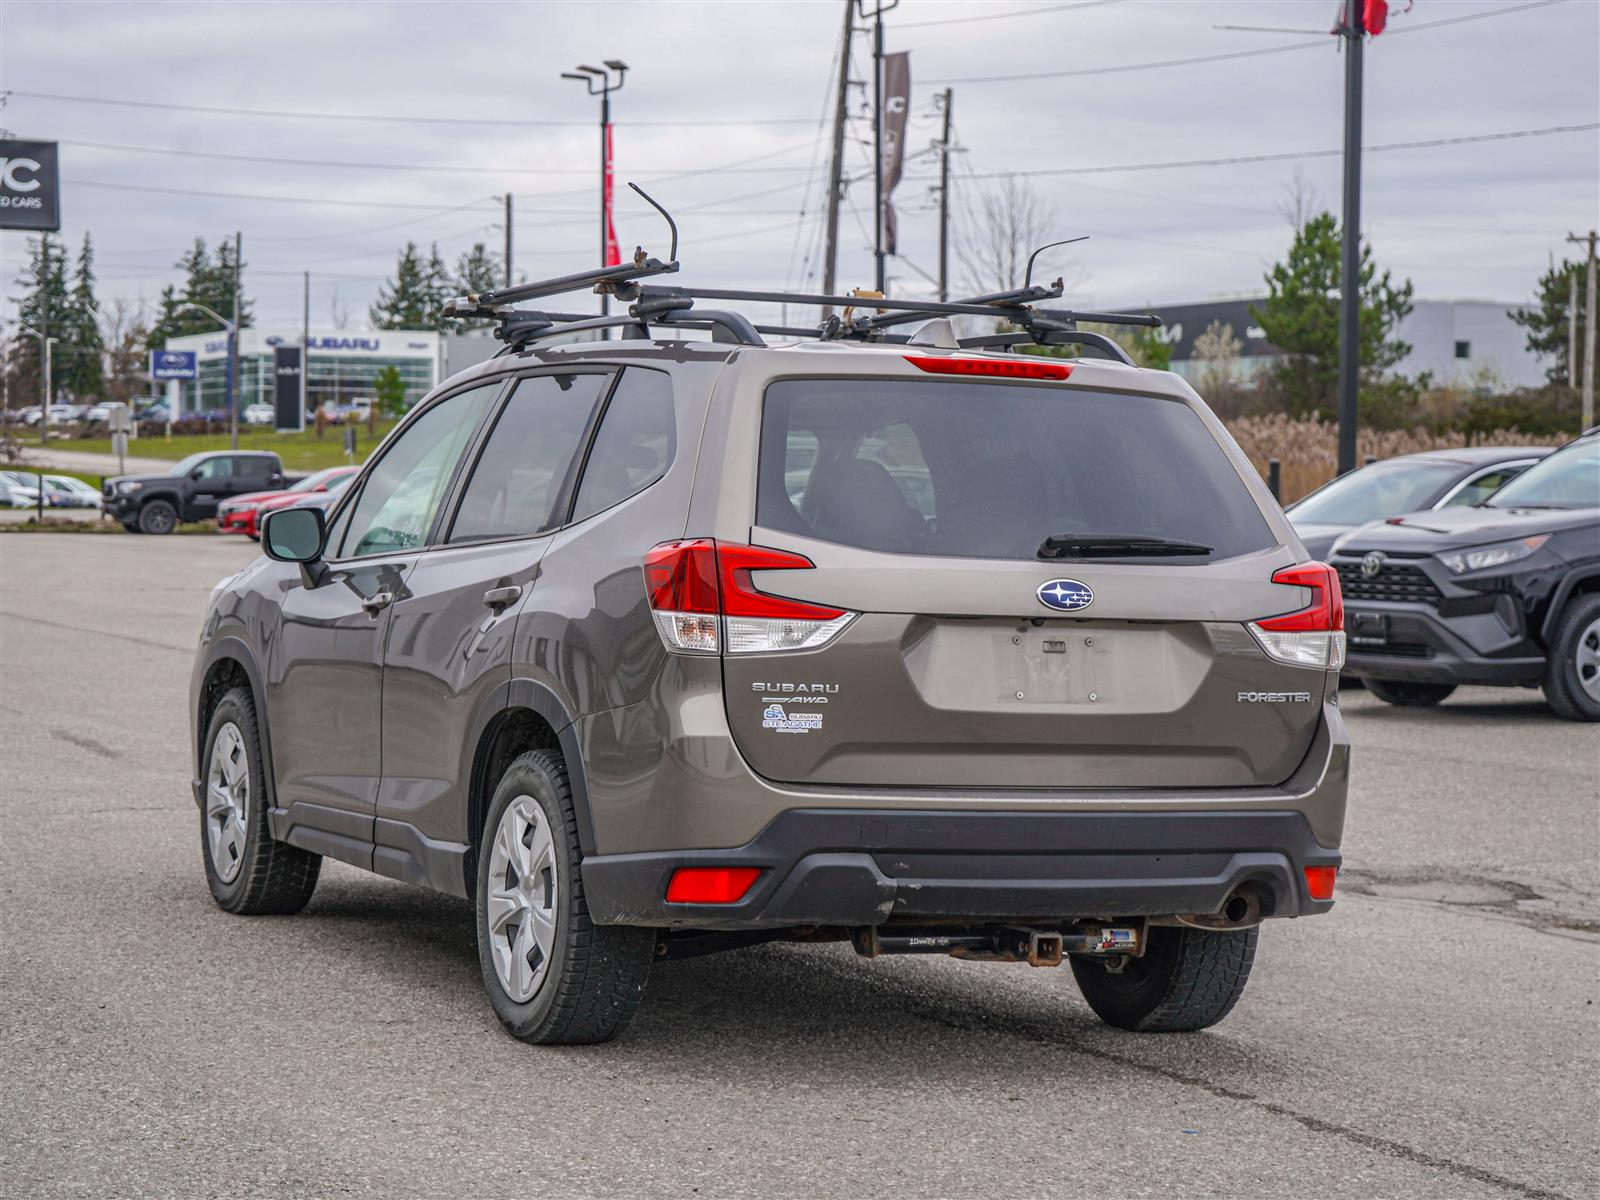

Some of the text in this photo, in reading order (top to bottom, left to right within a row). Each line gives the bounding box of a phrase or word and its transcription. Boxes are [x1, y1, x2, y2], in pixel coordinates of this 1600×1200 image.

[11, 196, 42, 209] CARS
[752, 682, 839, 693] SUBARU
[1237, 691, 1311, 703] FORESTER
[790, 713, 822, 721] SUBARU
